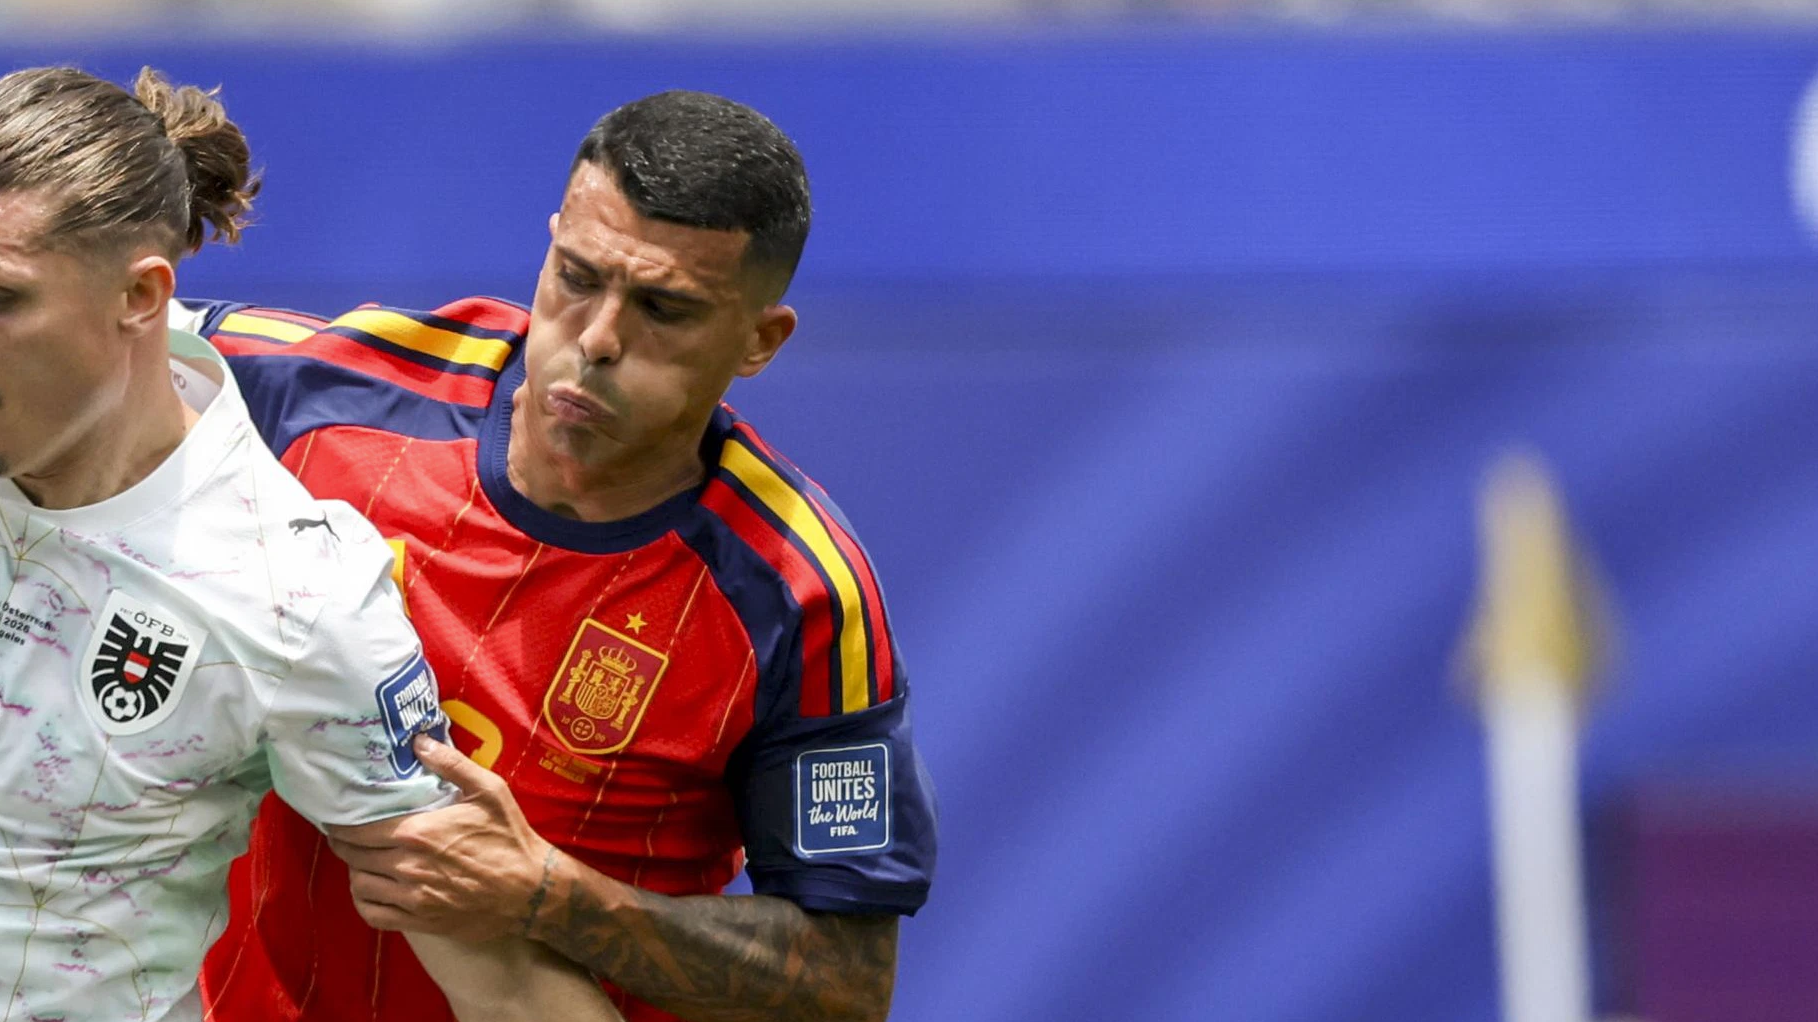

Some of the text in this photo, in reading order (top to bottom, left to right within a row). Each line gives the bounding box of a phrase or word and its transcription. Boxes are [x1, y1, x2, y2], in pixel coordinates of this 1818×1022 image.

[3, 616, 31, 633] 2026
[134, 610, 175, 637] ÖFB
[811, 760, 875, 779] FOOTBALL
[811, 776, 876, 803] UNITES
[807, 800, 880, 825] the World
[829, 825, 856, 837] FIFA
